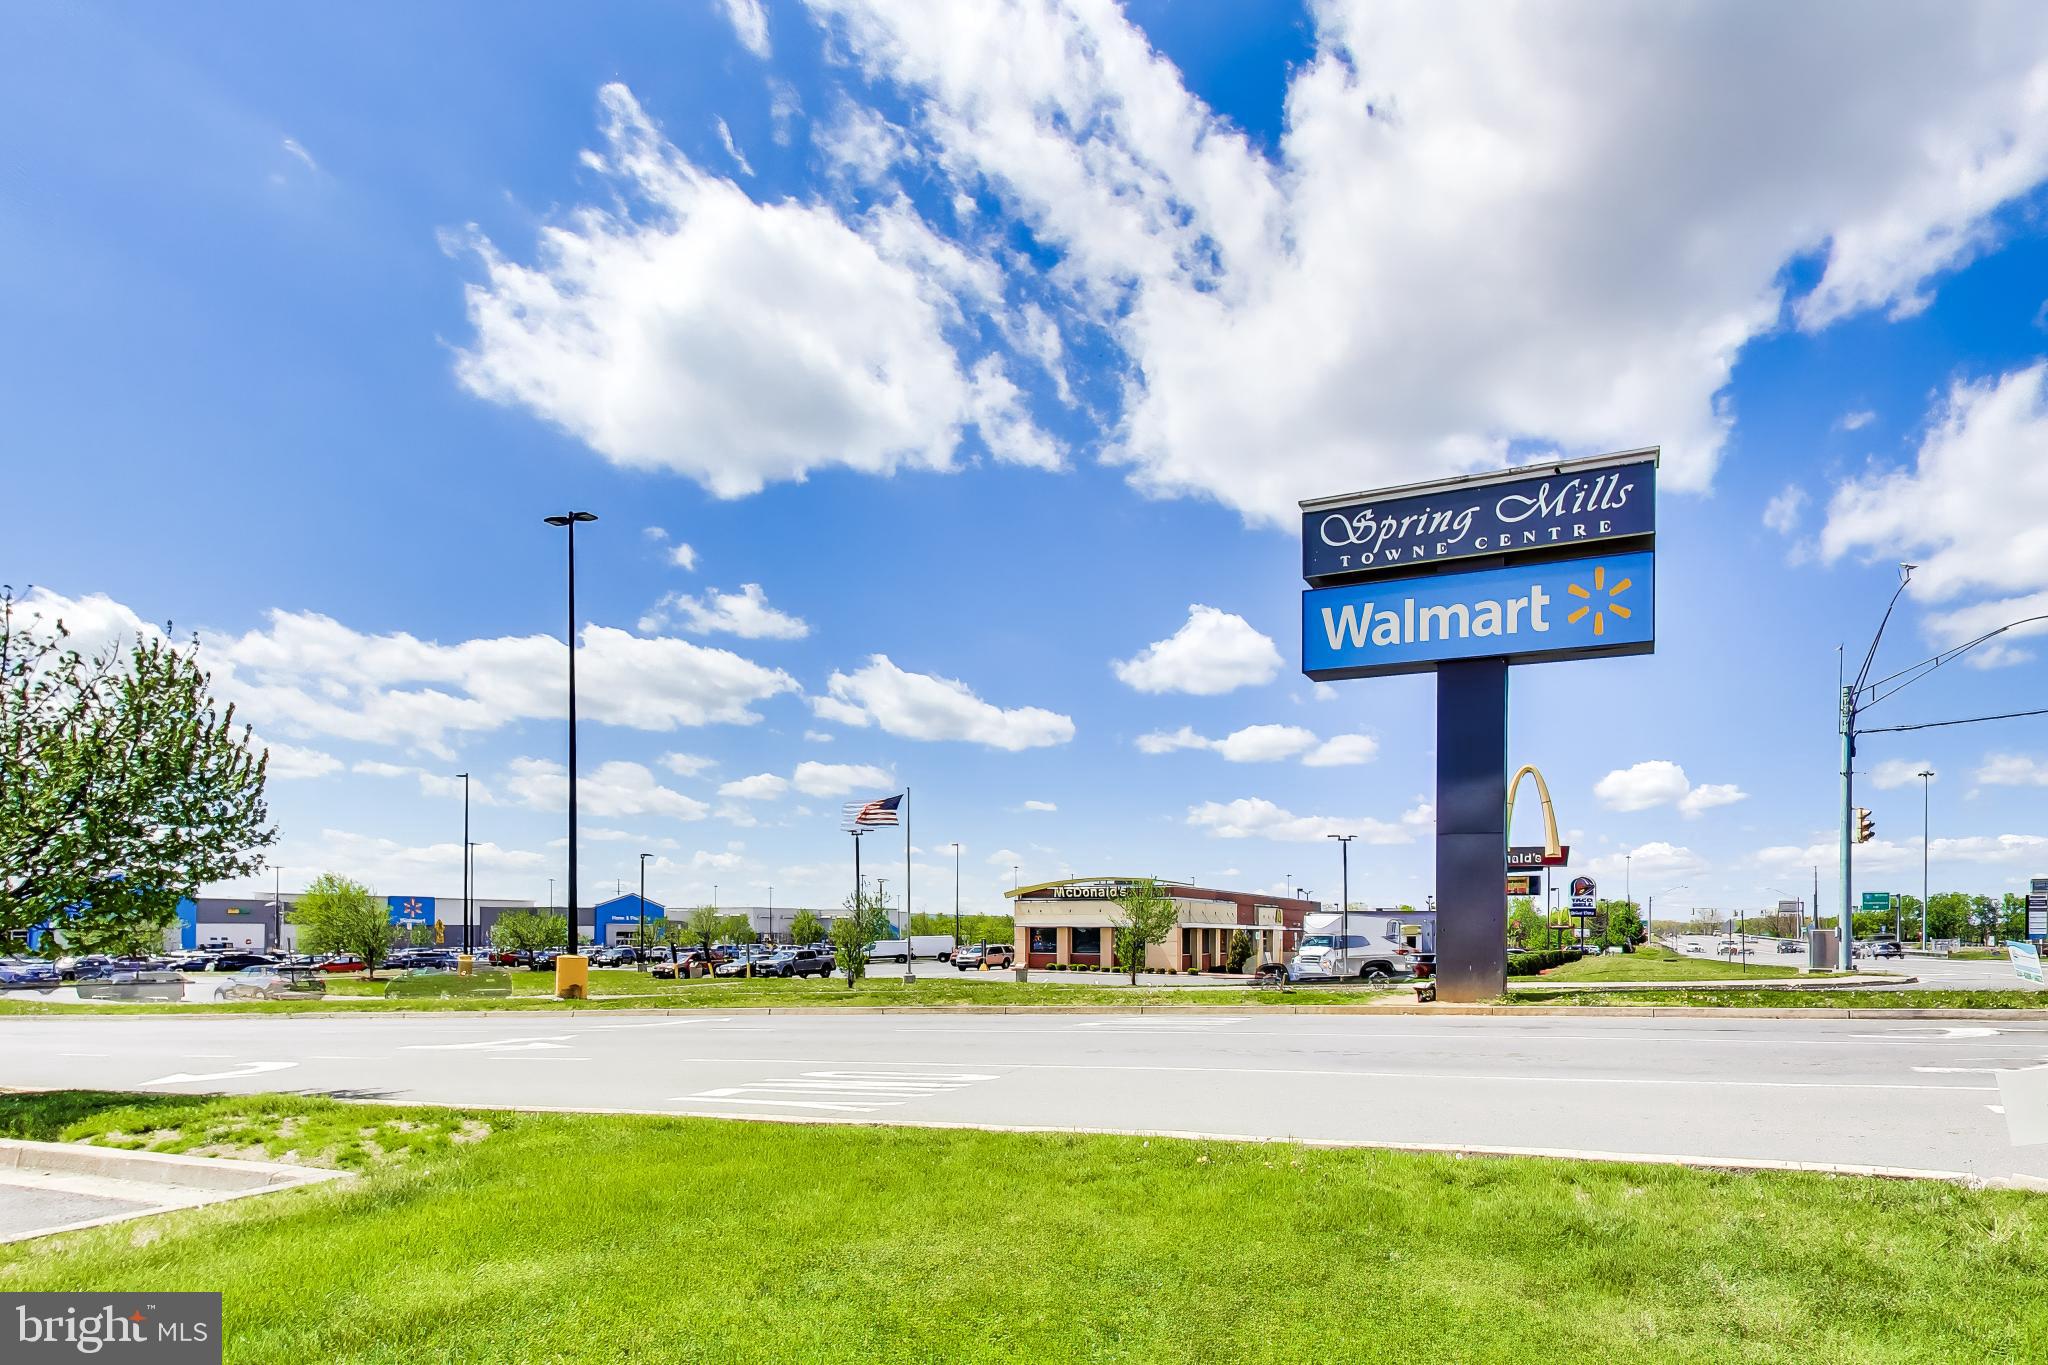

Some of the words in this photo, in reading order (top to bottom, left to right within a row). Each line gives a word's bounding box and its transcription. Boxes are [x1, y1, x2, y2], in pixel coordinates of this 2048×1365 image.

[1320, 506, 1480, 553] Spring
[1495, 473, 1634, 523] Mills
[1340, 542, 1448, 567] TOWNE
[1474, 520, 1612, 549] CENTRE
[1321, 585, 1550, 650] Walmart
[1053, 886, 1127, 898] McDonald's
